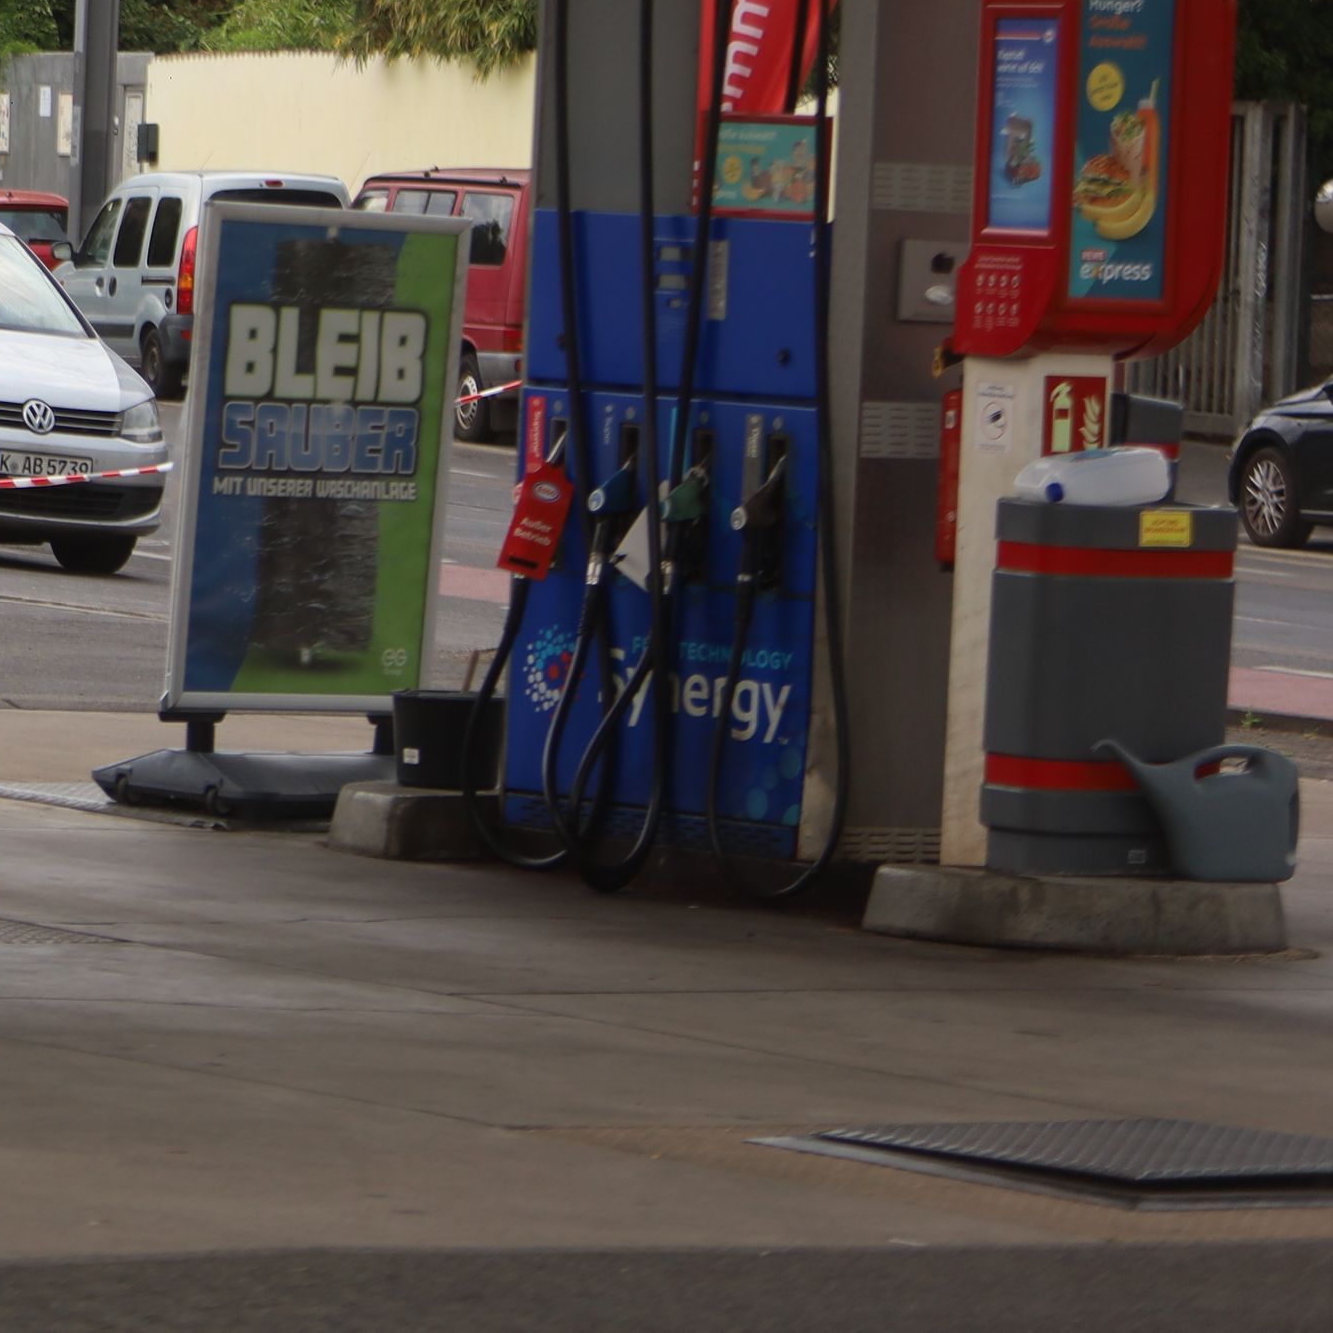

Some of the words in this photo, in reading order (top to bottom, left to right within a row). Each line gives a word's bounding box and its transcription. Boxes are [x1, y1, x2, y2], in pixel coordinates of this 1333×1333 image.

[1079, 262, 1153, 282] express
[225, 305, 427, 403] BLEIB
[218, 401, 420, 475] SAUBER
[0, 453, 11, 472] K
[22, 456, 44, 474] AB
[213, 477, 243, 495] MIT
[246, 478, 313, 497] UNSERER
[316, 480, 417, 500] WASCHANLAGE
[513, 527, 552, 546] Betrieb
